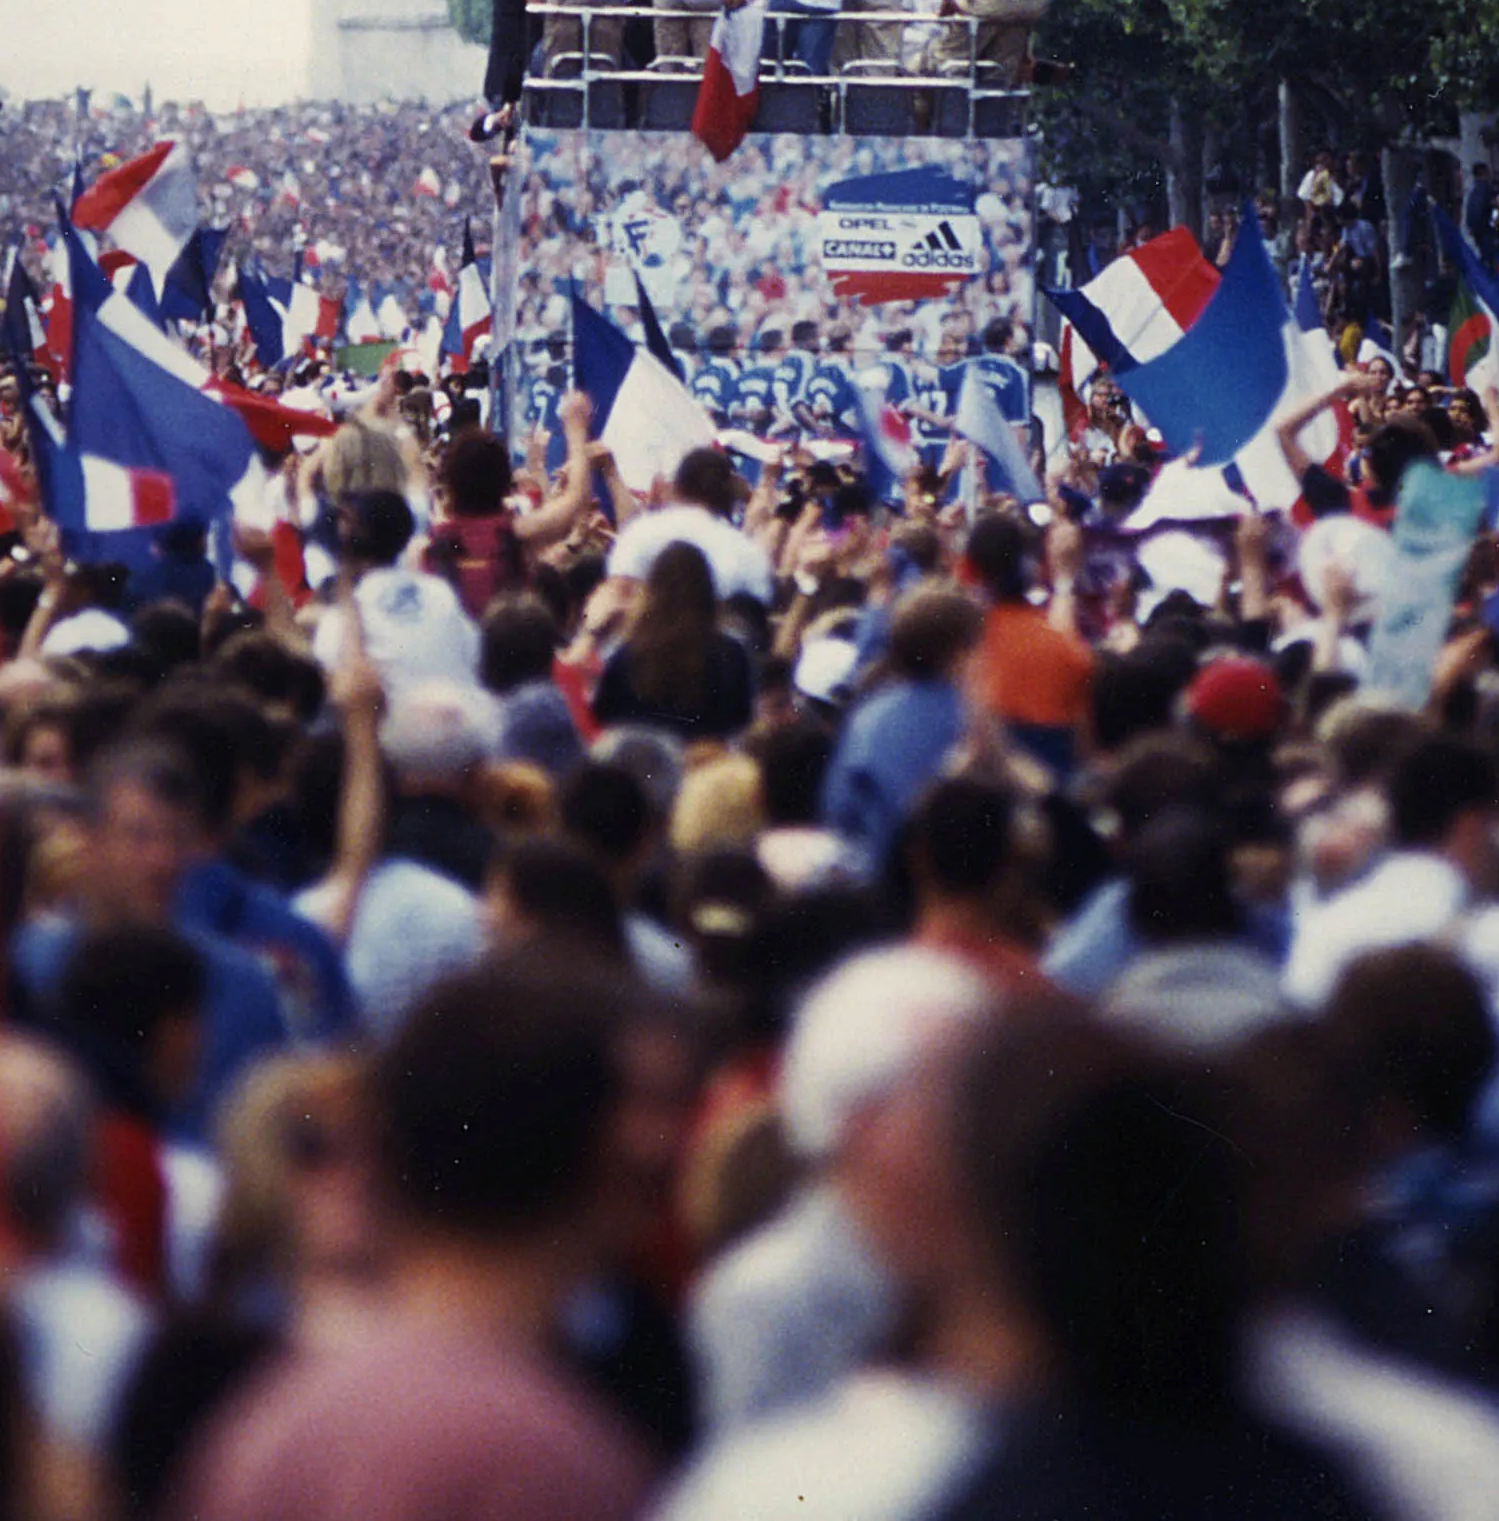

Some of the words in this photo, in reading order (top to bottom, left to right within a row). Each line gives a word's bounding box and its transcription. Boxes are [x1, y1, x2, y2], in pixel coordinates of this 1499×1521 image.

[839, 217, 894, 231] OPEL
[825, 240, 895, 258] CANAL+
[902, 250, 974, 268] adidas
